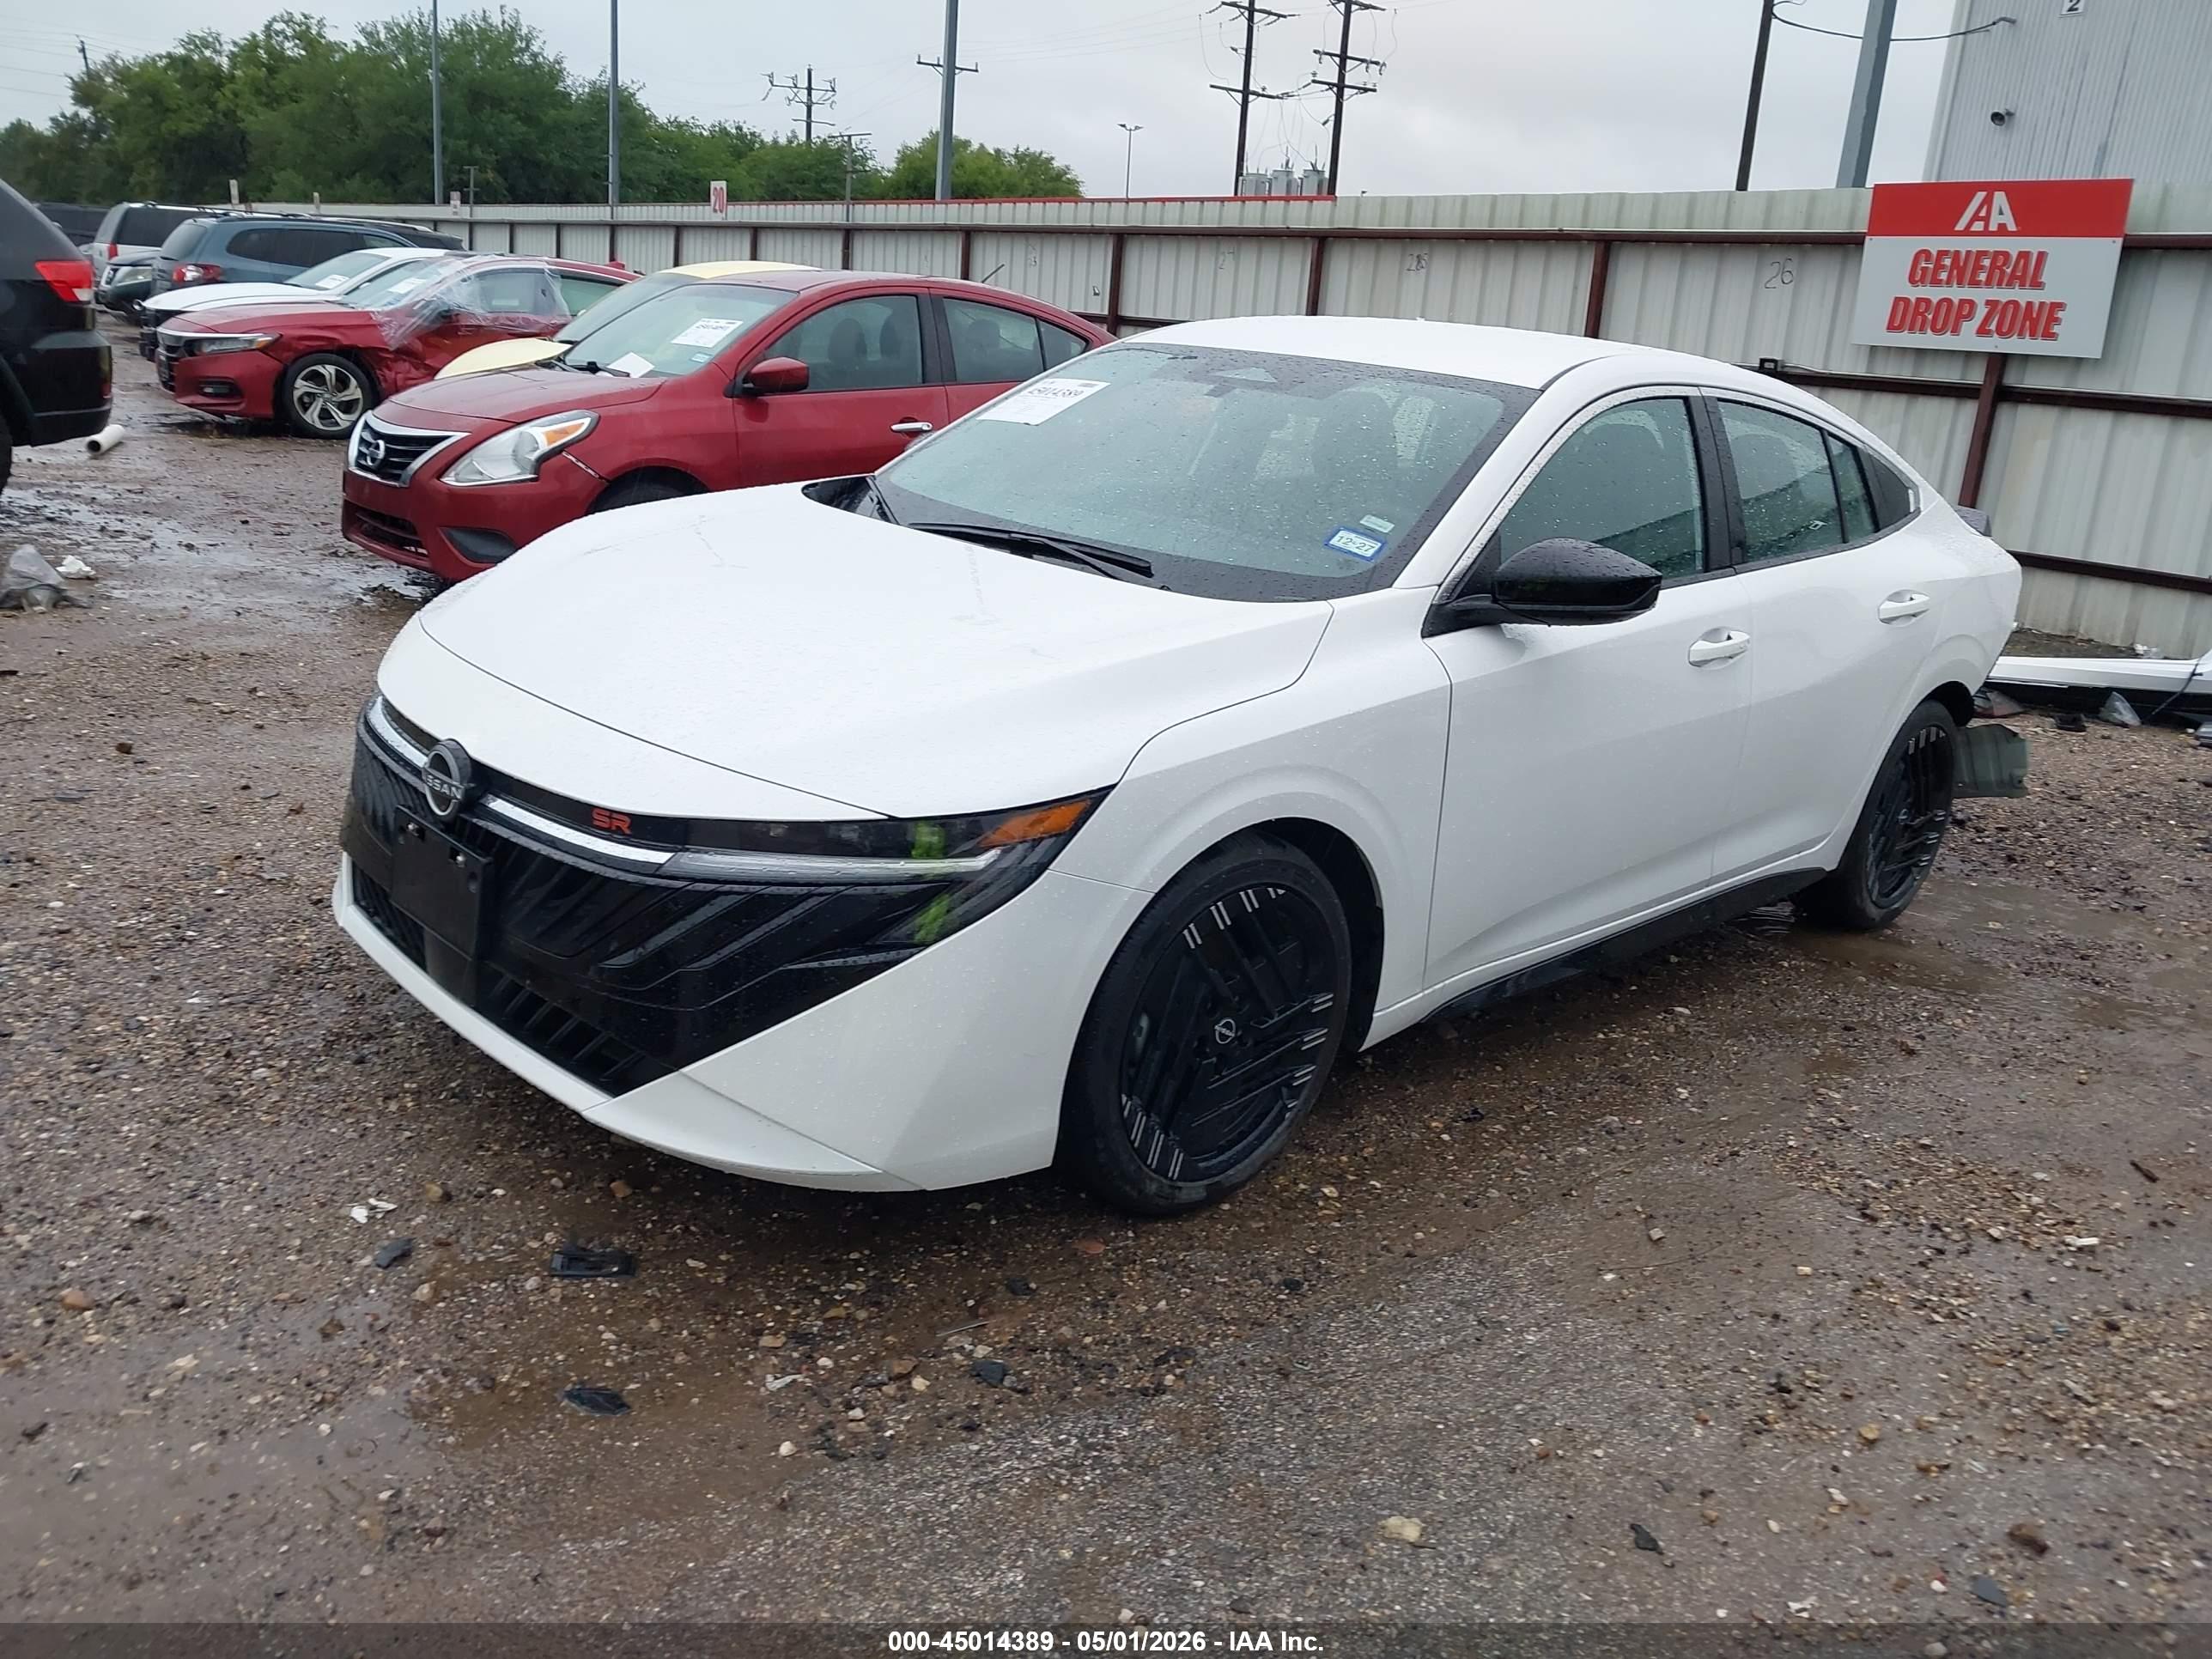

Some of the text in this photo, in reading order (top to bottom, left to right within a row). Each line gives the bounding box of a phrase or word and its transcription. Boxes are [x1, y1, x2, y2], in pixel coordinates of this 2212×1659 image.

[1765, 258, 1794, 289] 26
[1908, 248, 2049, 290] GENERAL
[1886, 296, 2067, 341] DROP ZONE
[591, 808, 632, 836] SR
